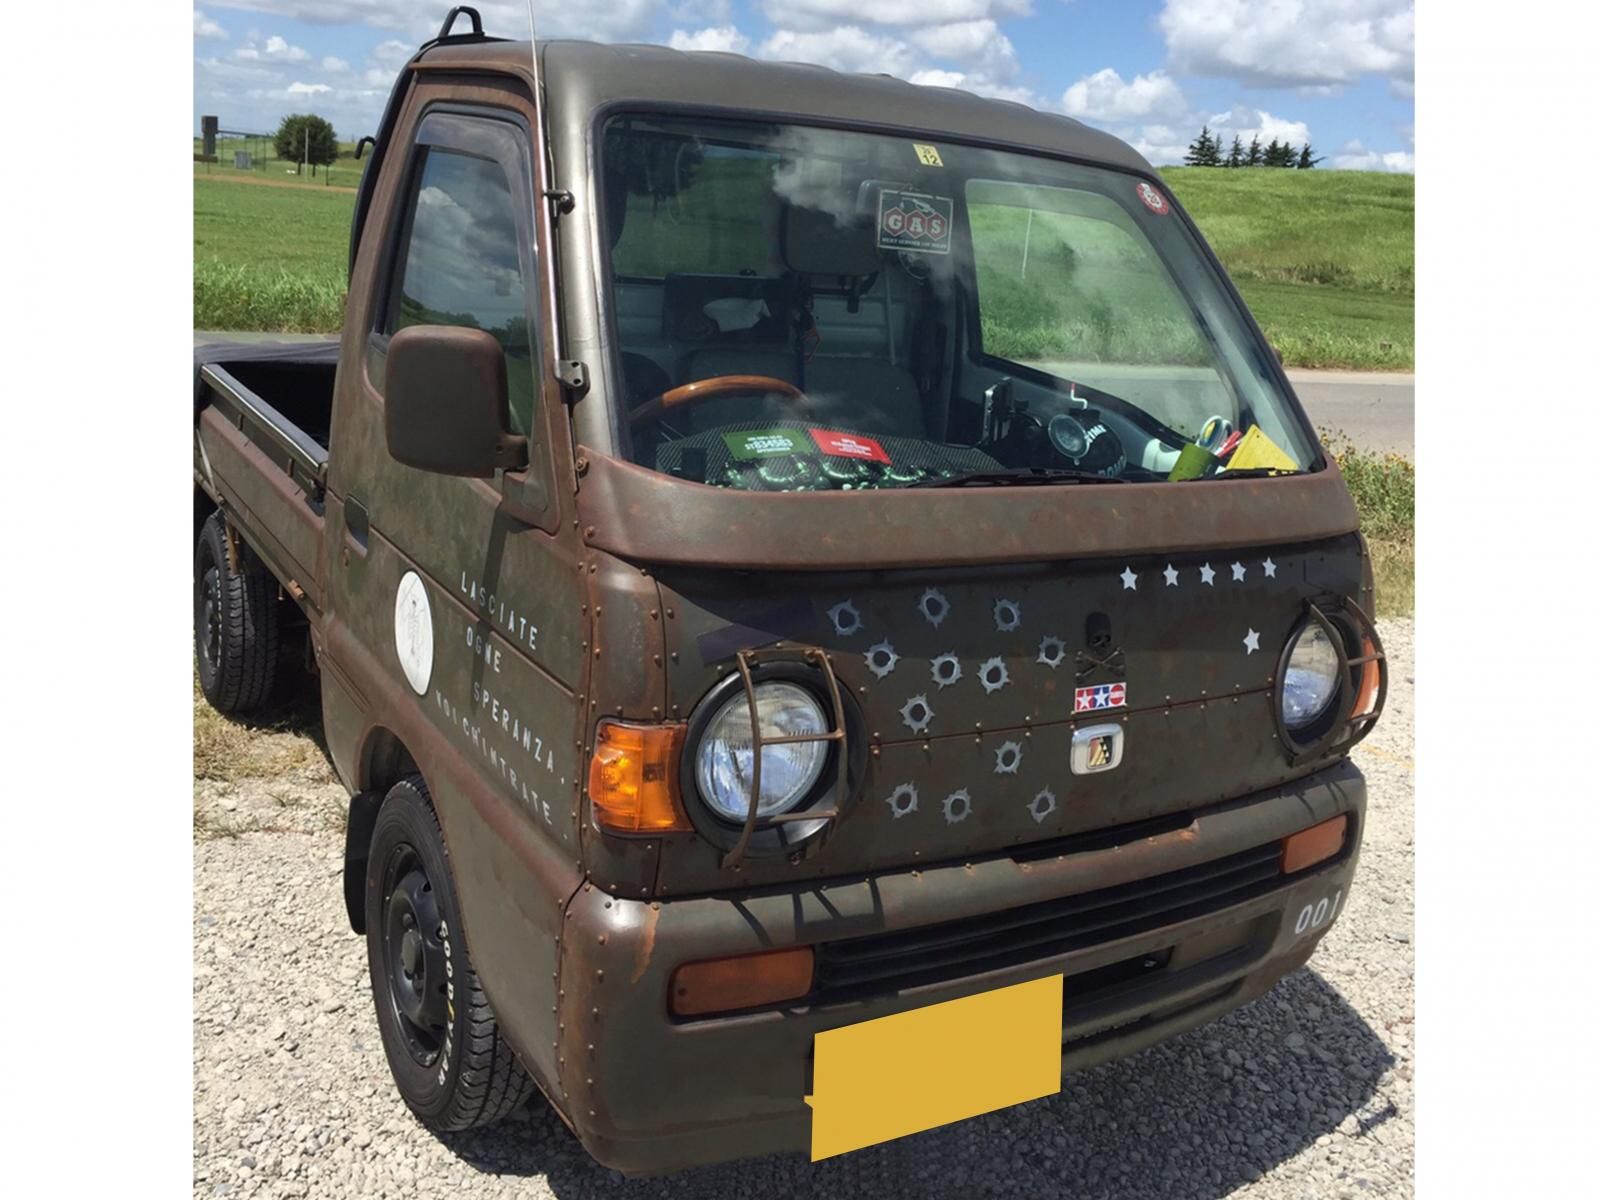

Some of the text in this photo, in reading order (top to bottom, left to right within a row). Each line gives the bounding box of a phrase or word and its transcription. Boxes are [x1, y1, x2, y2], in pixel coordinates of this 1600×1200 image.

[922, 154, 940, 165] 12
[887, 213, 943, 235] GAS
[461, 571, 537, 651] LASCIATE
[1294, 890, 1342, 934] 001
[438, 920, 455, 1086] GOODYEAR
